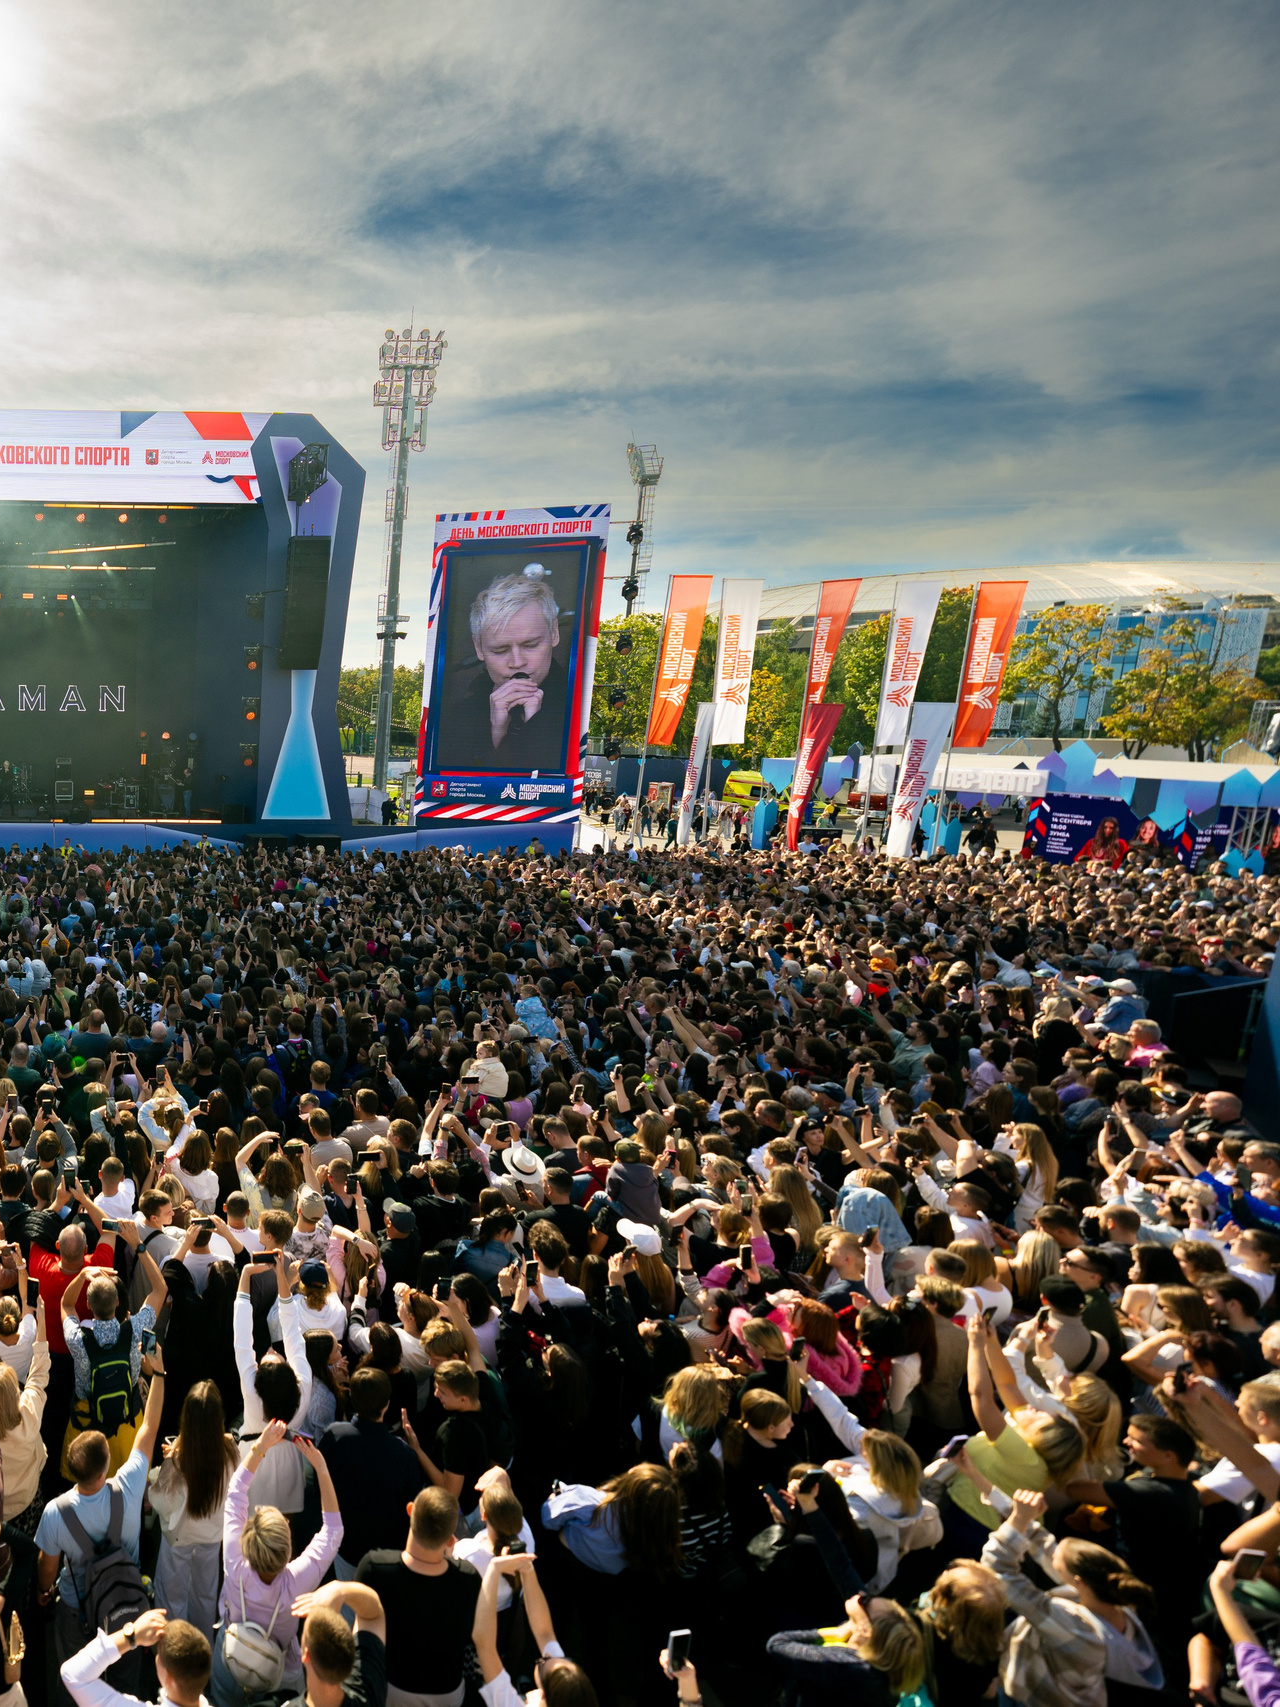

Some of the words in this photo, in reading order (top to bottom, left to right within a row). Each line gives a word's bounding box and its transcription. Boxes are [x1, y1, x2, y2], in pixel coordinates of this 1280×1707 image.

[75, 446, 130, 466] СПОРТА
[215, 449, 249, 458] МОСКОВСКИЙ
[450, 527, 474, 541] ДЕНЬ
[477, 522, 549, 538] МОСКОВСКОГО
[552, 520, 592, 534] СПОРТА
[662, 612, 688, 679] МОСКОВСКИЙ
[721, 614, 741, 680] МОСКОВСКИЙ
[811, 616, 832, 683] МОСКОВСКИЙ
[890, 617, 914, 682] МОСКОВСКИЙ
[967, 617, 997, 684] МОСКОВСКИЙ
[678, 647, 697, 680] СПОРТ
[736, 649, 752, 679] СПОРТ
[902, 651, 922, 682] СПОРТ
[984, 651, 1005, 683] СПОРТ
[519, 783, 565, 793] МОСКОВСКИЙ
[688, 765, 700, 791] СПОРТ
[798, 769, 814, 796] СПОРТ
[908, 770, 929, 798] СПОРТ
[518, 792, 540, 801] СПОРТ
[1059, 817, 1092, 826] СЕНТЯБРЯ
